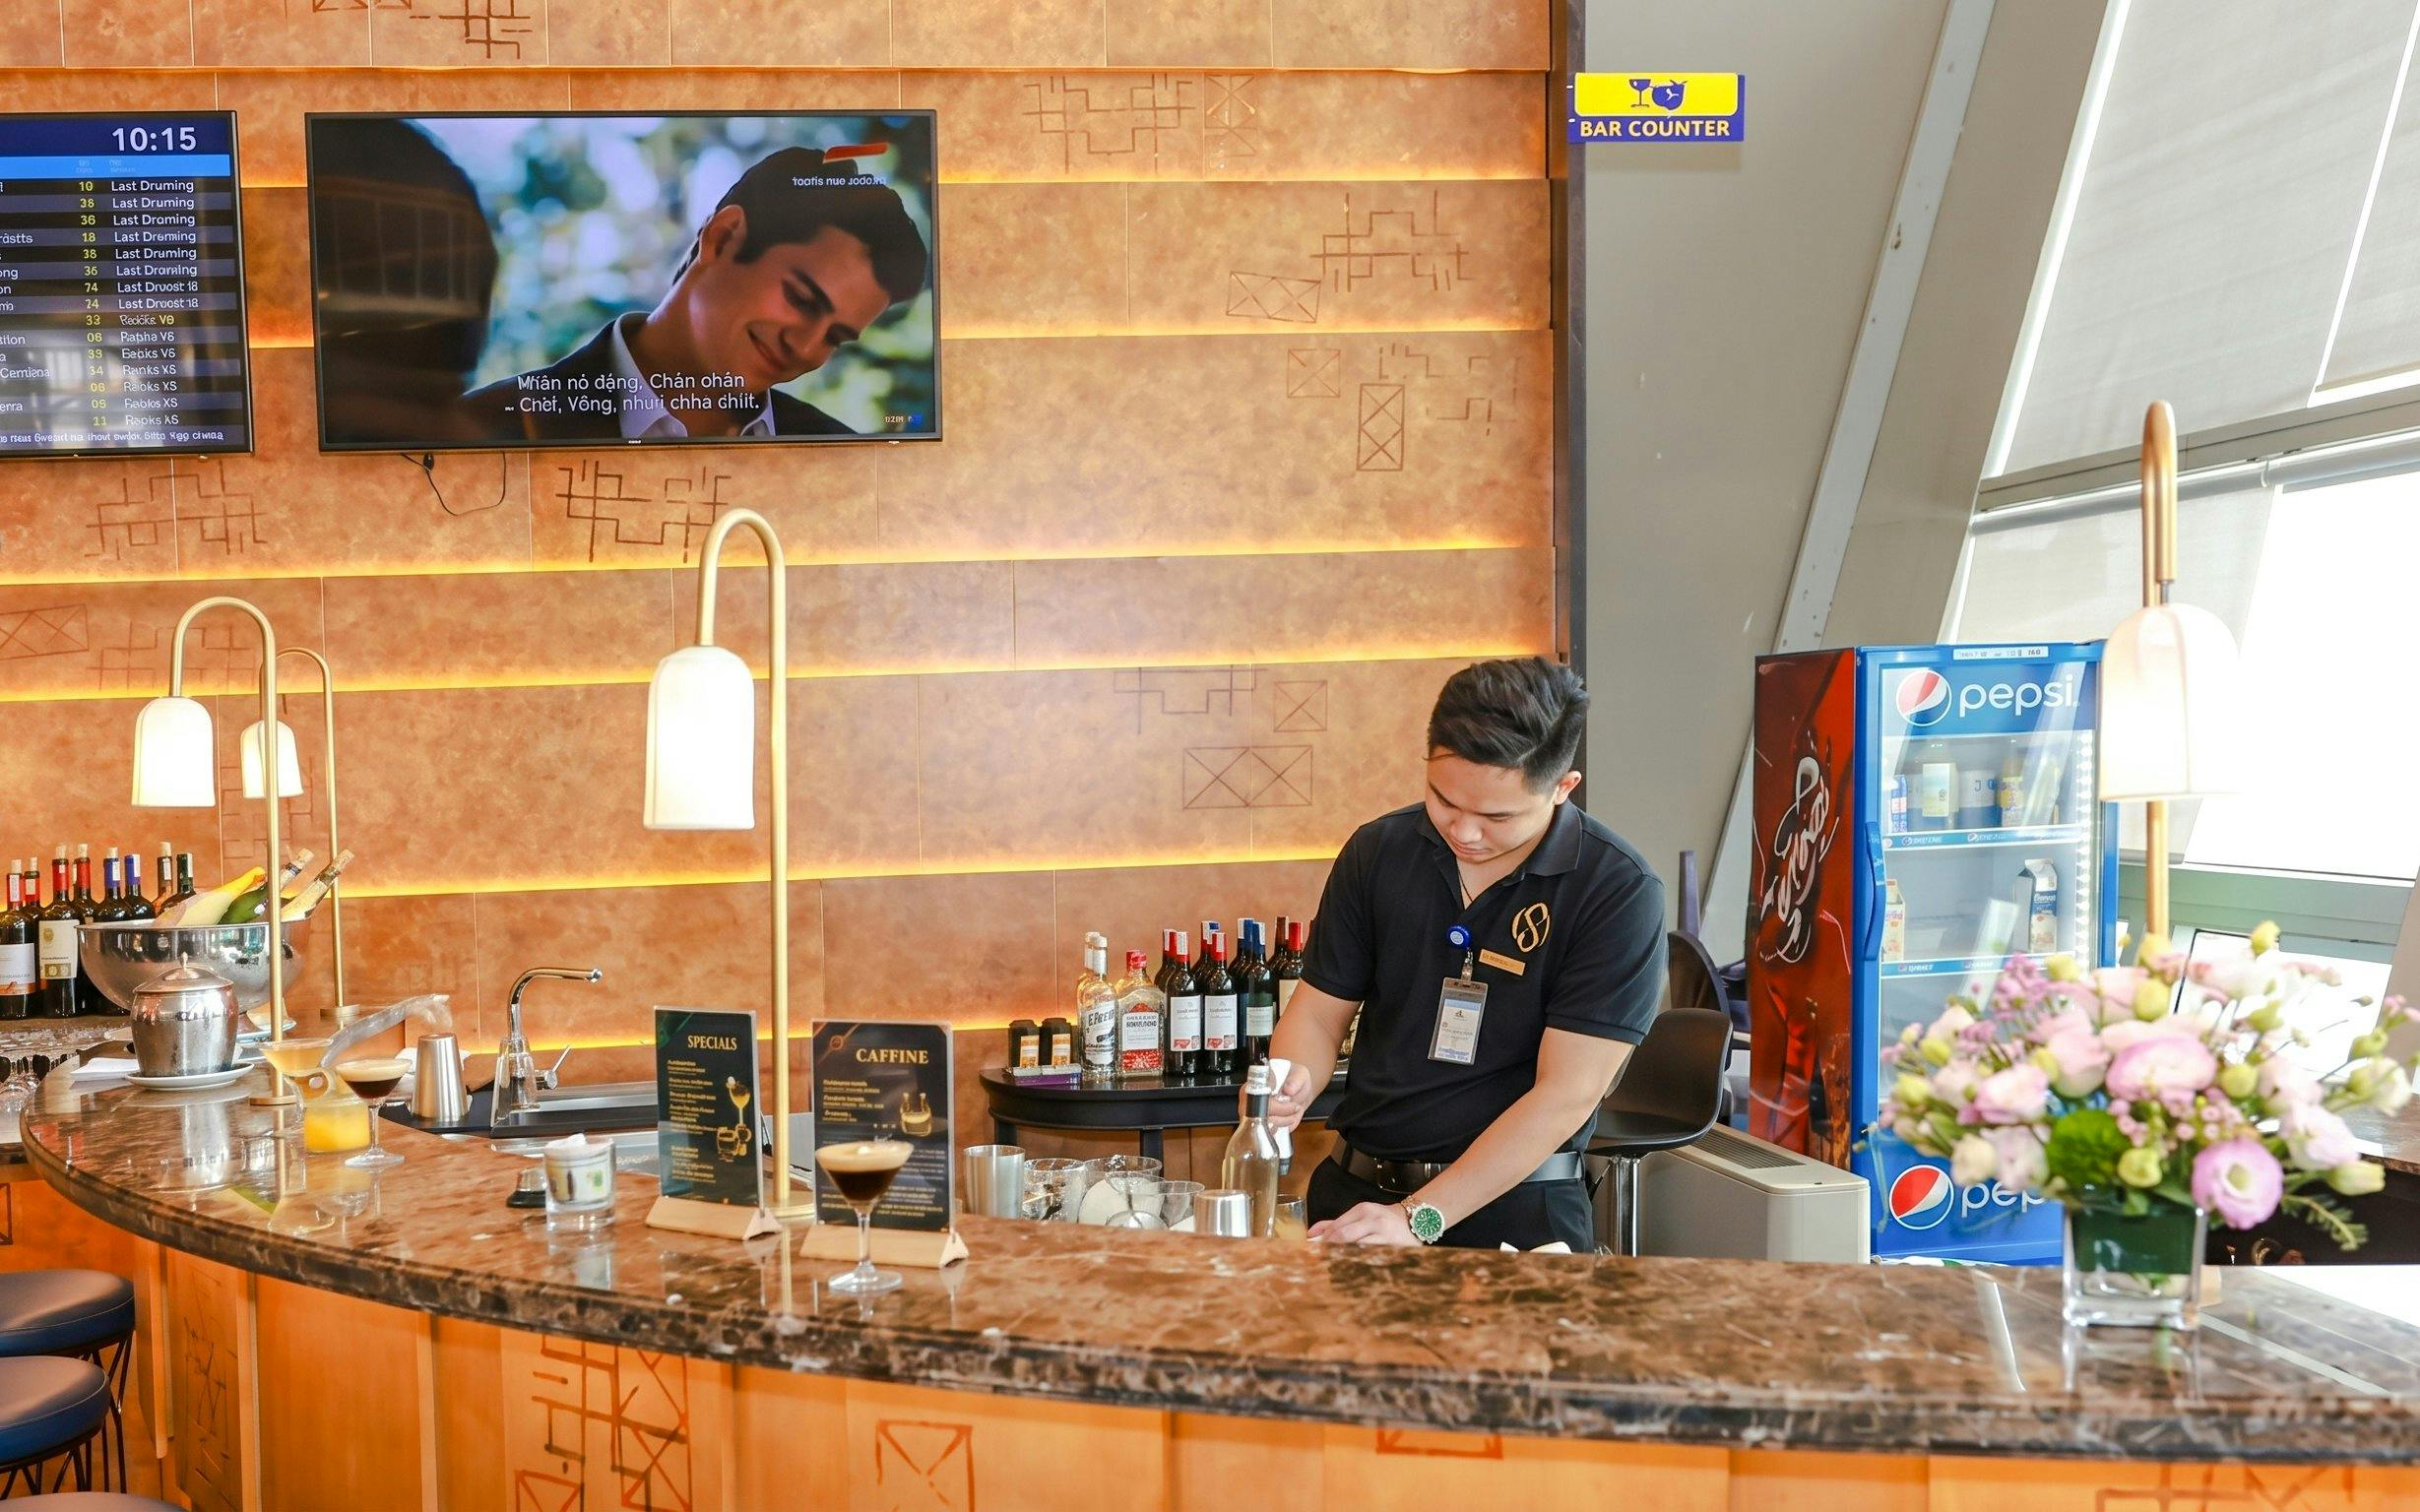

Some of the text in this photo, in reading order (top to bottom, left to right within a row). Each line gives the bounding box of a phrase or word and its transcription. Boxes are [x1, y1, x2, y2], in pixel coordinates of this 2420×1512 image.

[1580, 120, 1731, 137] BAR COUNTER
[112, 126, 197, 152] 10:15
[79, 180, 194, 193] 10 Last Druming
[80, 197, 195, 210] 38 Last Druming
[80, 215, 96, 225] 36
[113, 215, 139, 225] Last
[82, 232, 96, 242] 18
[114, 231, 140, 242] Last
[115, 249, 141, 259] Last
[116, 265, 141, 276] Last
[117, 283, 143, 293] Last
[1959, 673, 2074, 718] pepsi
[687, 1035, 737, 1050] SPECIALS
[856, 1048, 929, 1064] CAFFINE
[1961, 1181, 2046, 1219] pep
